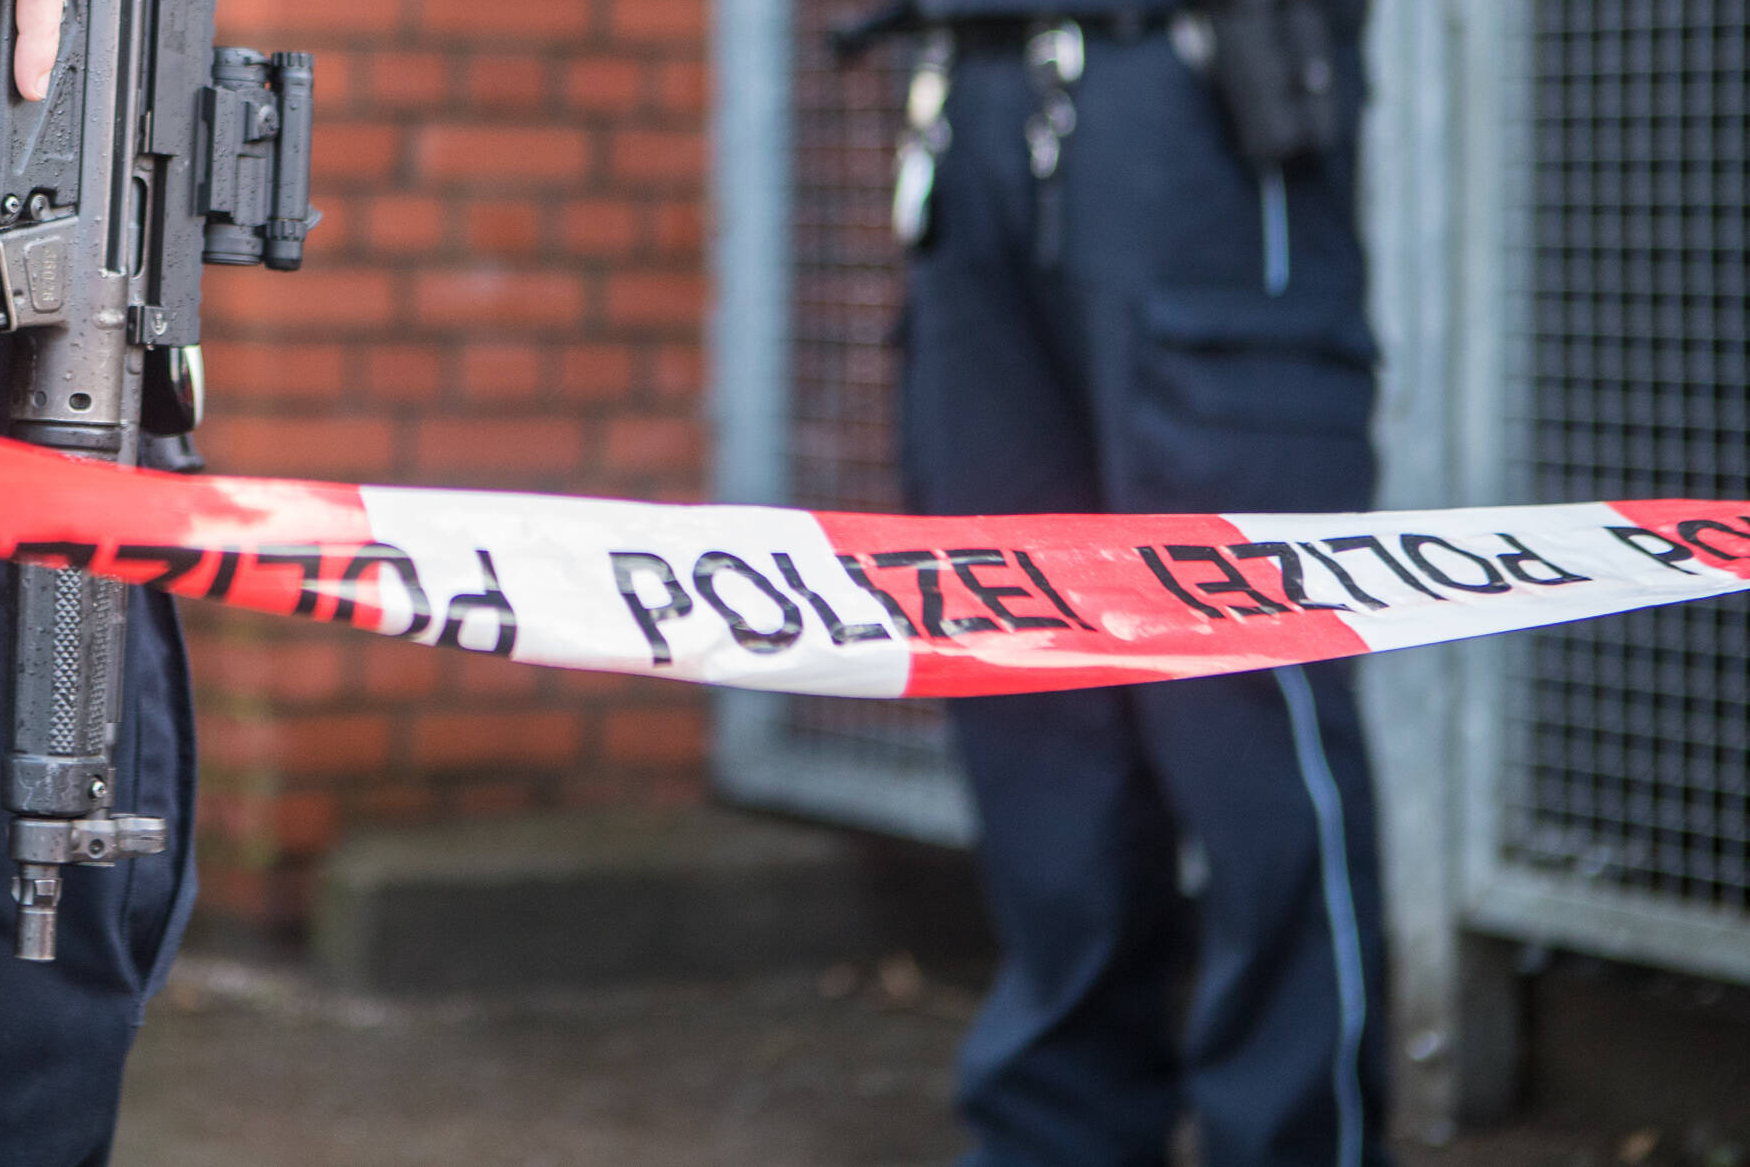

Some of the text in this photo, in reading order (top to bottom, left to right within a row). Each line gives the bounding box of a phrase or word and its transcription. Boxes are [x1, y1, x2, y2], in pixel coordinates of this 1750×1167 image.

[1135, 532, 1594, 620] POLIZEI
[1602, 515, 1750, 576] PO
[607, 548, 1098, 667] POLIZEI
